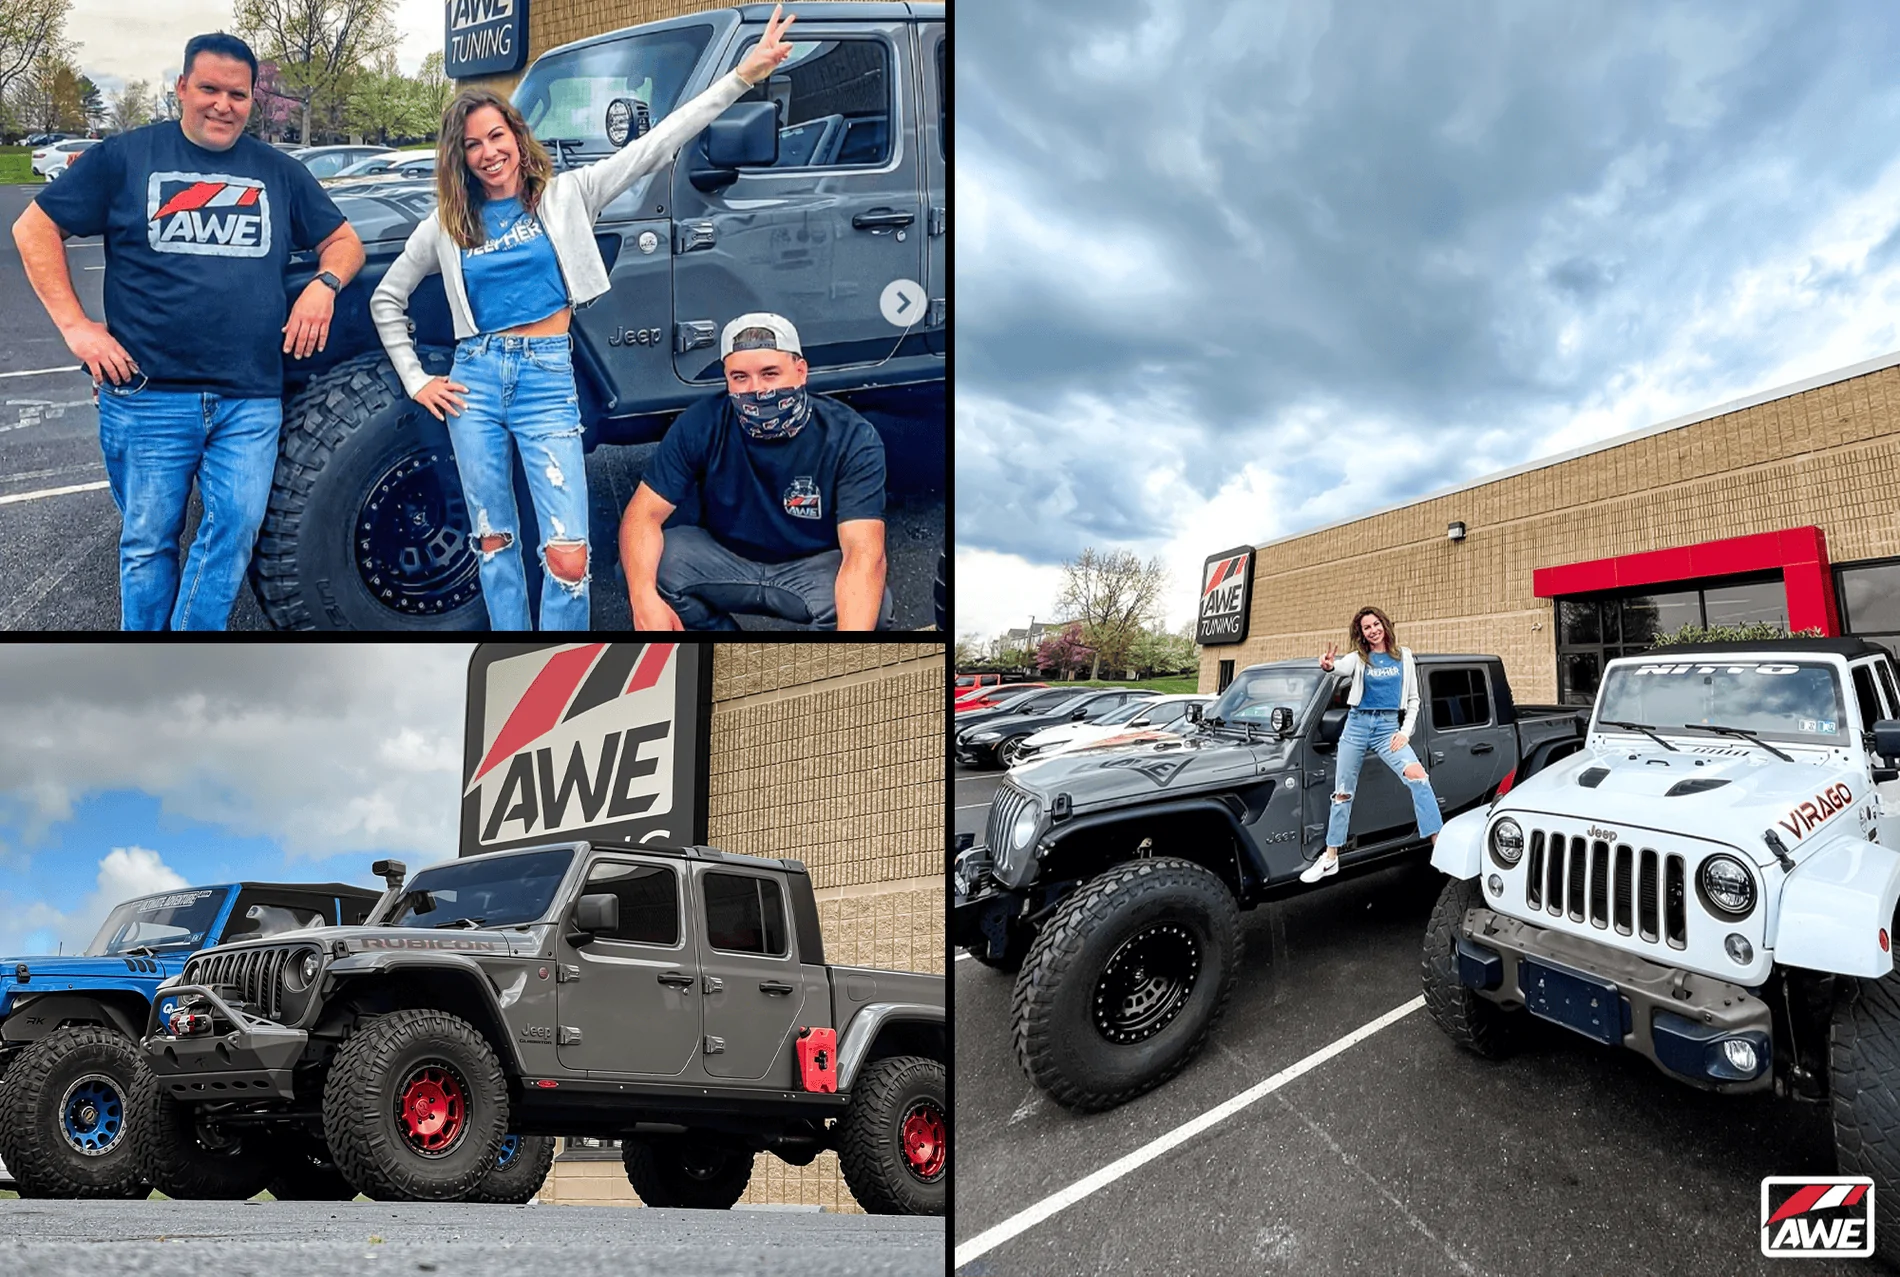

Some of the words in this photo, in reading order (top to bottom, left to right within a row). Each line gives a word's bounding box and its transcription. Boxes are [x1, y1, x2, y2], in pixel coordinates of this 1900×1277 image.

[452, 24, 512, 64] TUNING
[160, 210, 261, 246] AWE
[608, 326, 662, 347] Jeep
[789, 505, 818, 518] AWE
[1202, 583, 1243, 617] AWE
[1201, 615, 1241, 637] TUNING
[1634, 663, 1800, 676] NITTO
[480, 720, 672, 842] AWE
[1777, 782, 1853, 841] VIRAGO
[1587, 824, 1618, 843] Jeep
[360, 938, 496, 951] RUBICON
[26, 1016, 46, 1026] RK
[520, 1022, 552, 1040] Jeep
